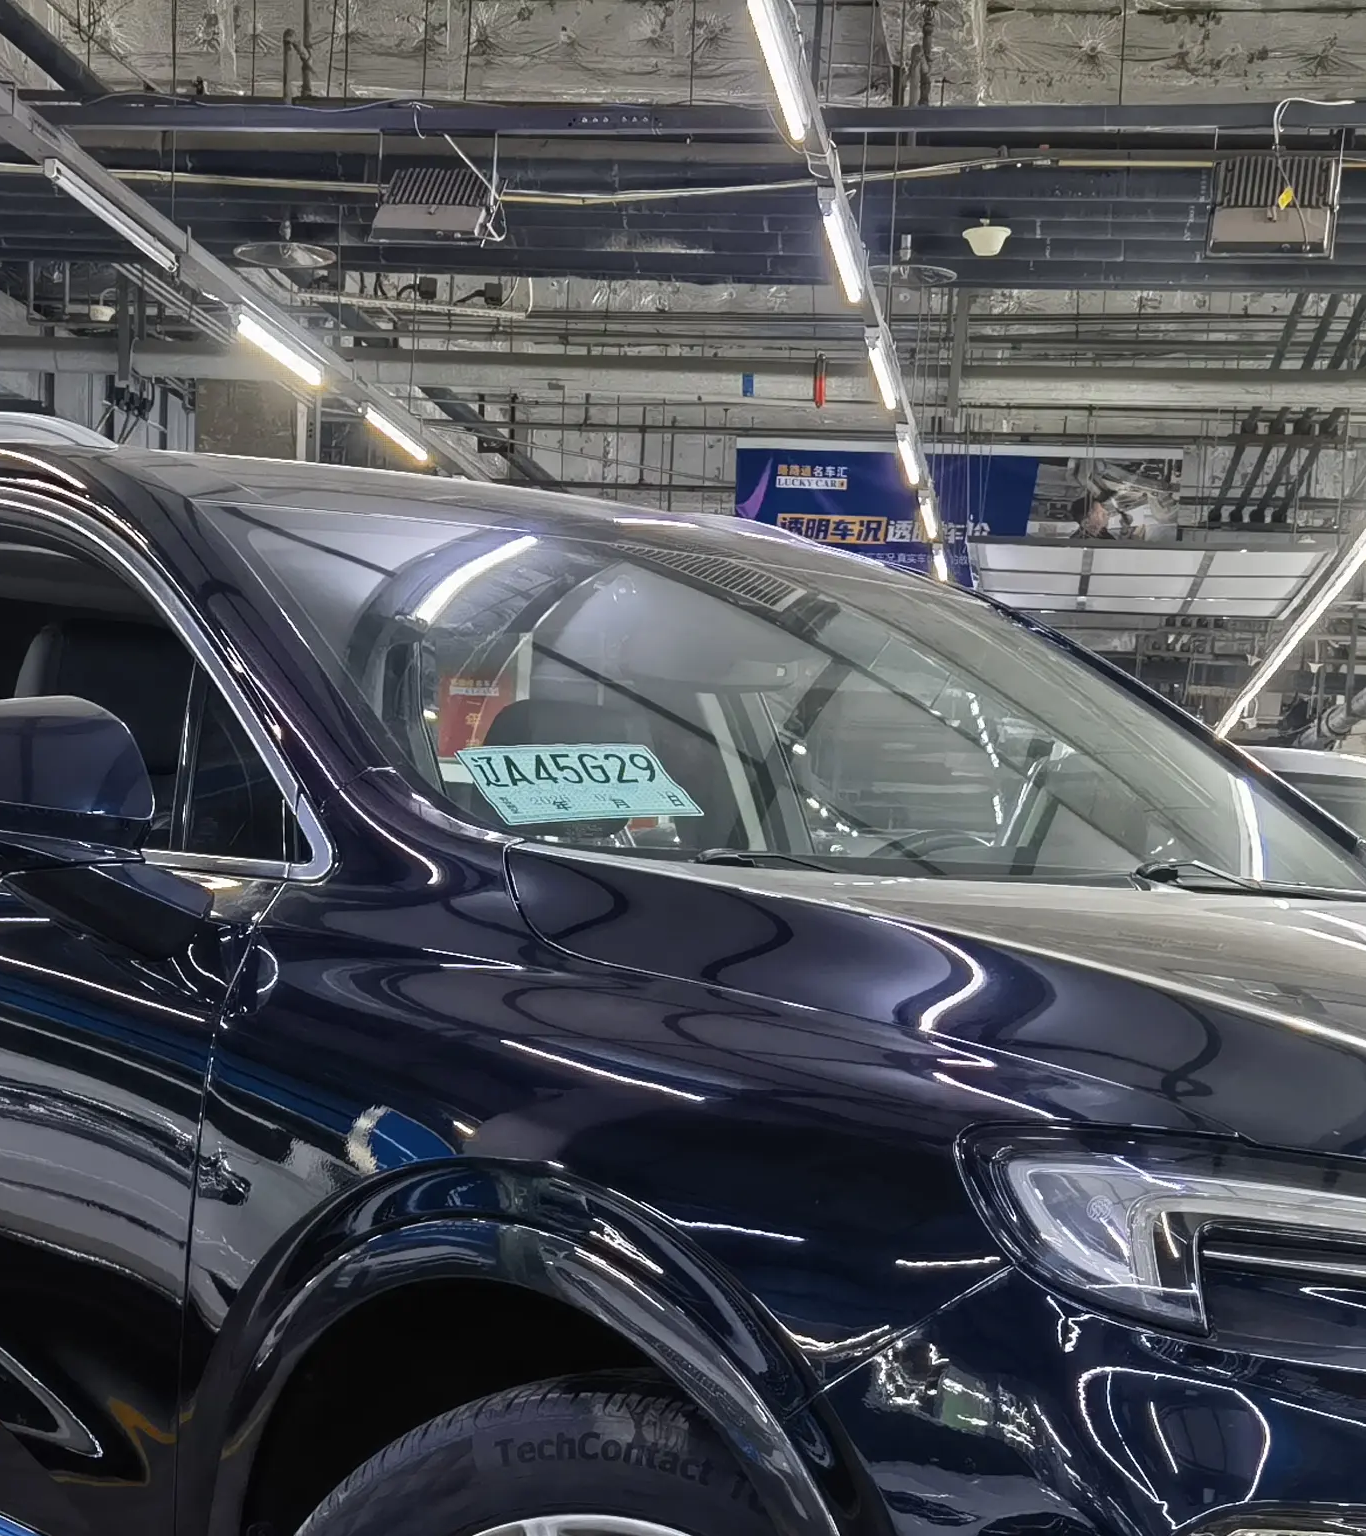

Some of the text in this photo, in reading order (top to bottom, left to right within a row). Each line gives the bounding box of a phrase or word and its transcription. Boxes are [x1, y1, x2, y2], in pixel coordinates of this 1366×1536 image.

[777, 478, 838, 490] LUCKY CAR
[473, 753, 657, 788] 辽A45G29
[494, 1431, 715, 1487] TechContact
